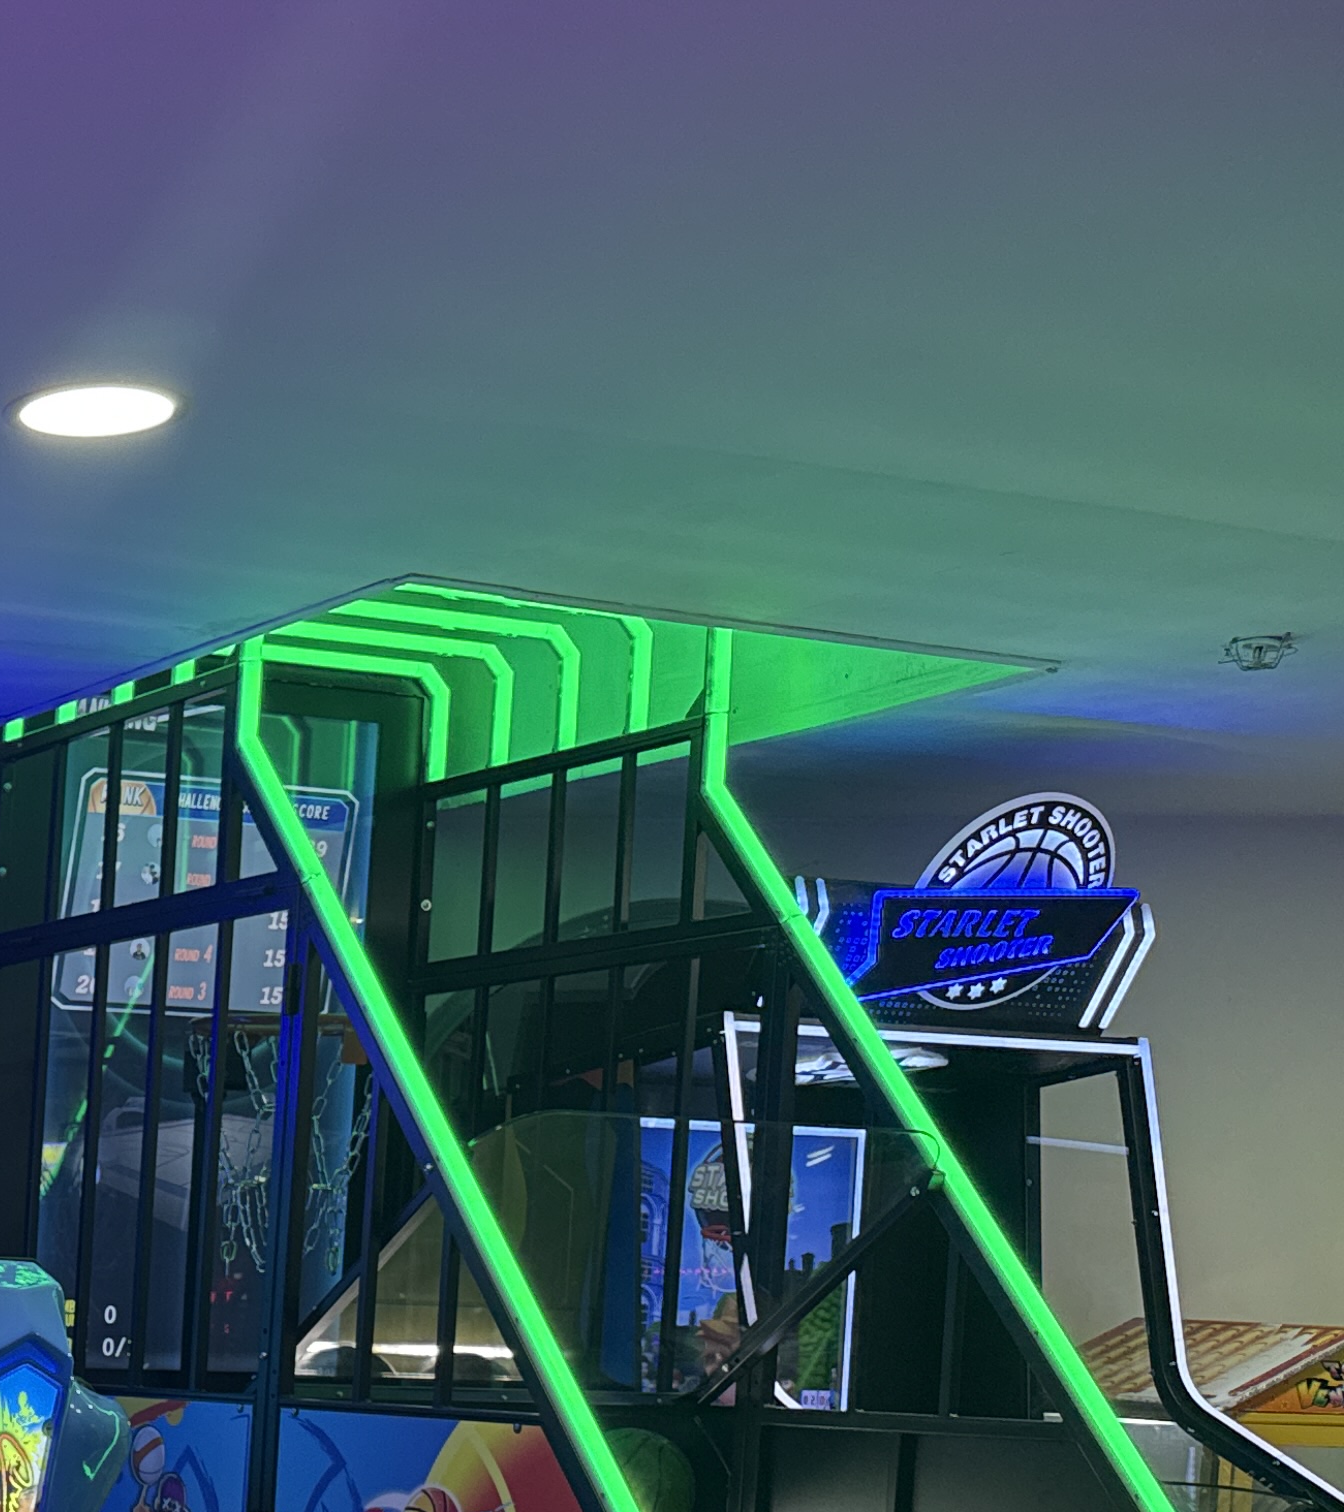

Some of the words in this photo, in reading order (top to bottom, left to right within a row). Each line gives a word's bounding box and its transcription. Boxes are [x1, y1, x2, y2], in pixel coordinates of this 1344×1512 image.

[938, 804, 1045, 883] STARLET
[1048, 804, 1110, 890] SHOOTER
[892, 908, 1041, 940] STARLET
[934, 934, 1054, 971] SHOOTER
[103, 1304, 117, 1325] 0
